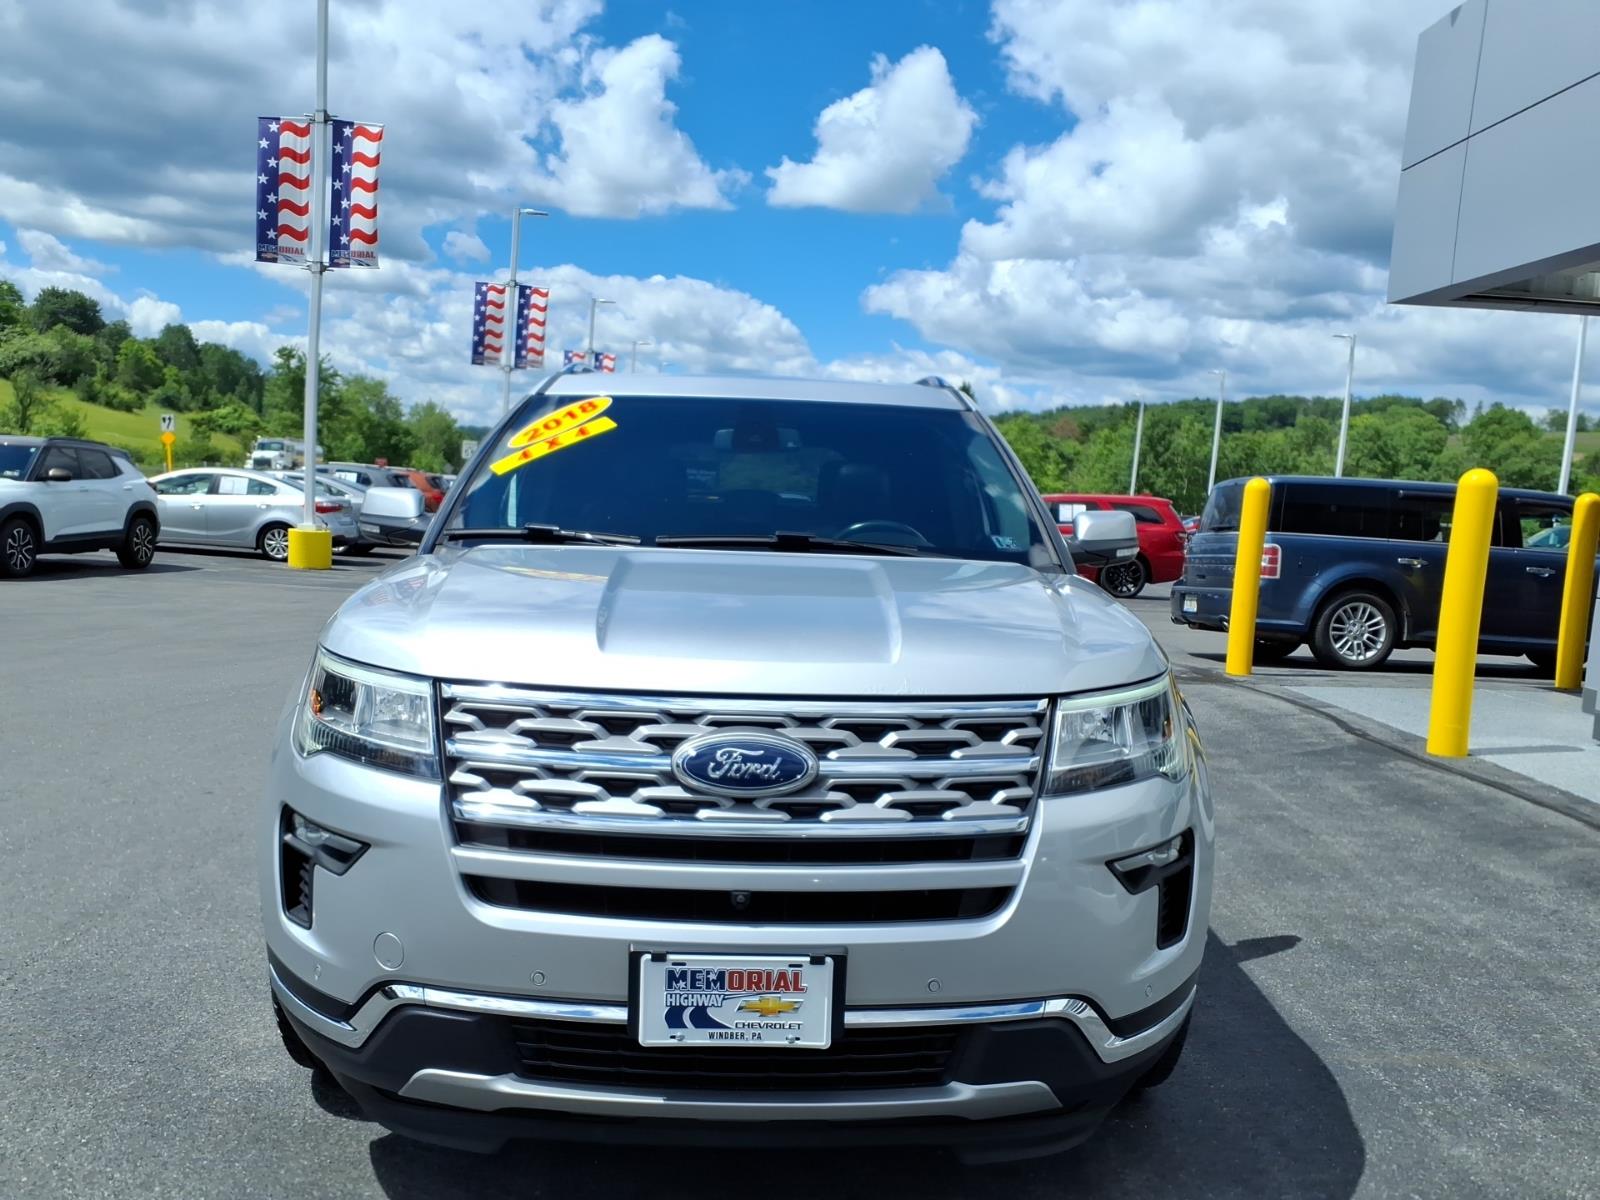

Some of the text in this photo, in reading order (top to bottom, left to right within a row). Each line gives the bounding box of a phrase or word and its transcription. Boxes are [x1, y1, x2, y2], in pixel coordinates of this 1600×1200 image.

[706, 747, 783, 779] Ford
[665, 968, 807, 993] MEMORIAL
[665, 993, 725, 1007] HIGHWAY
[734, 1021, 803, 1030] CHEVROLET
[708, 1031, 763, 1041] WINDBER, PA
